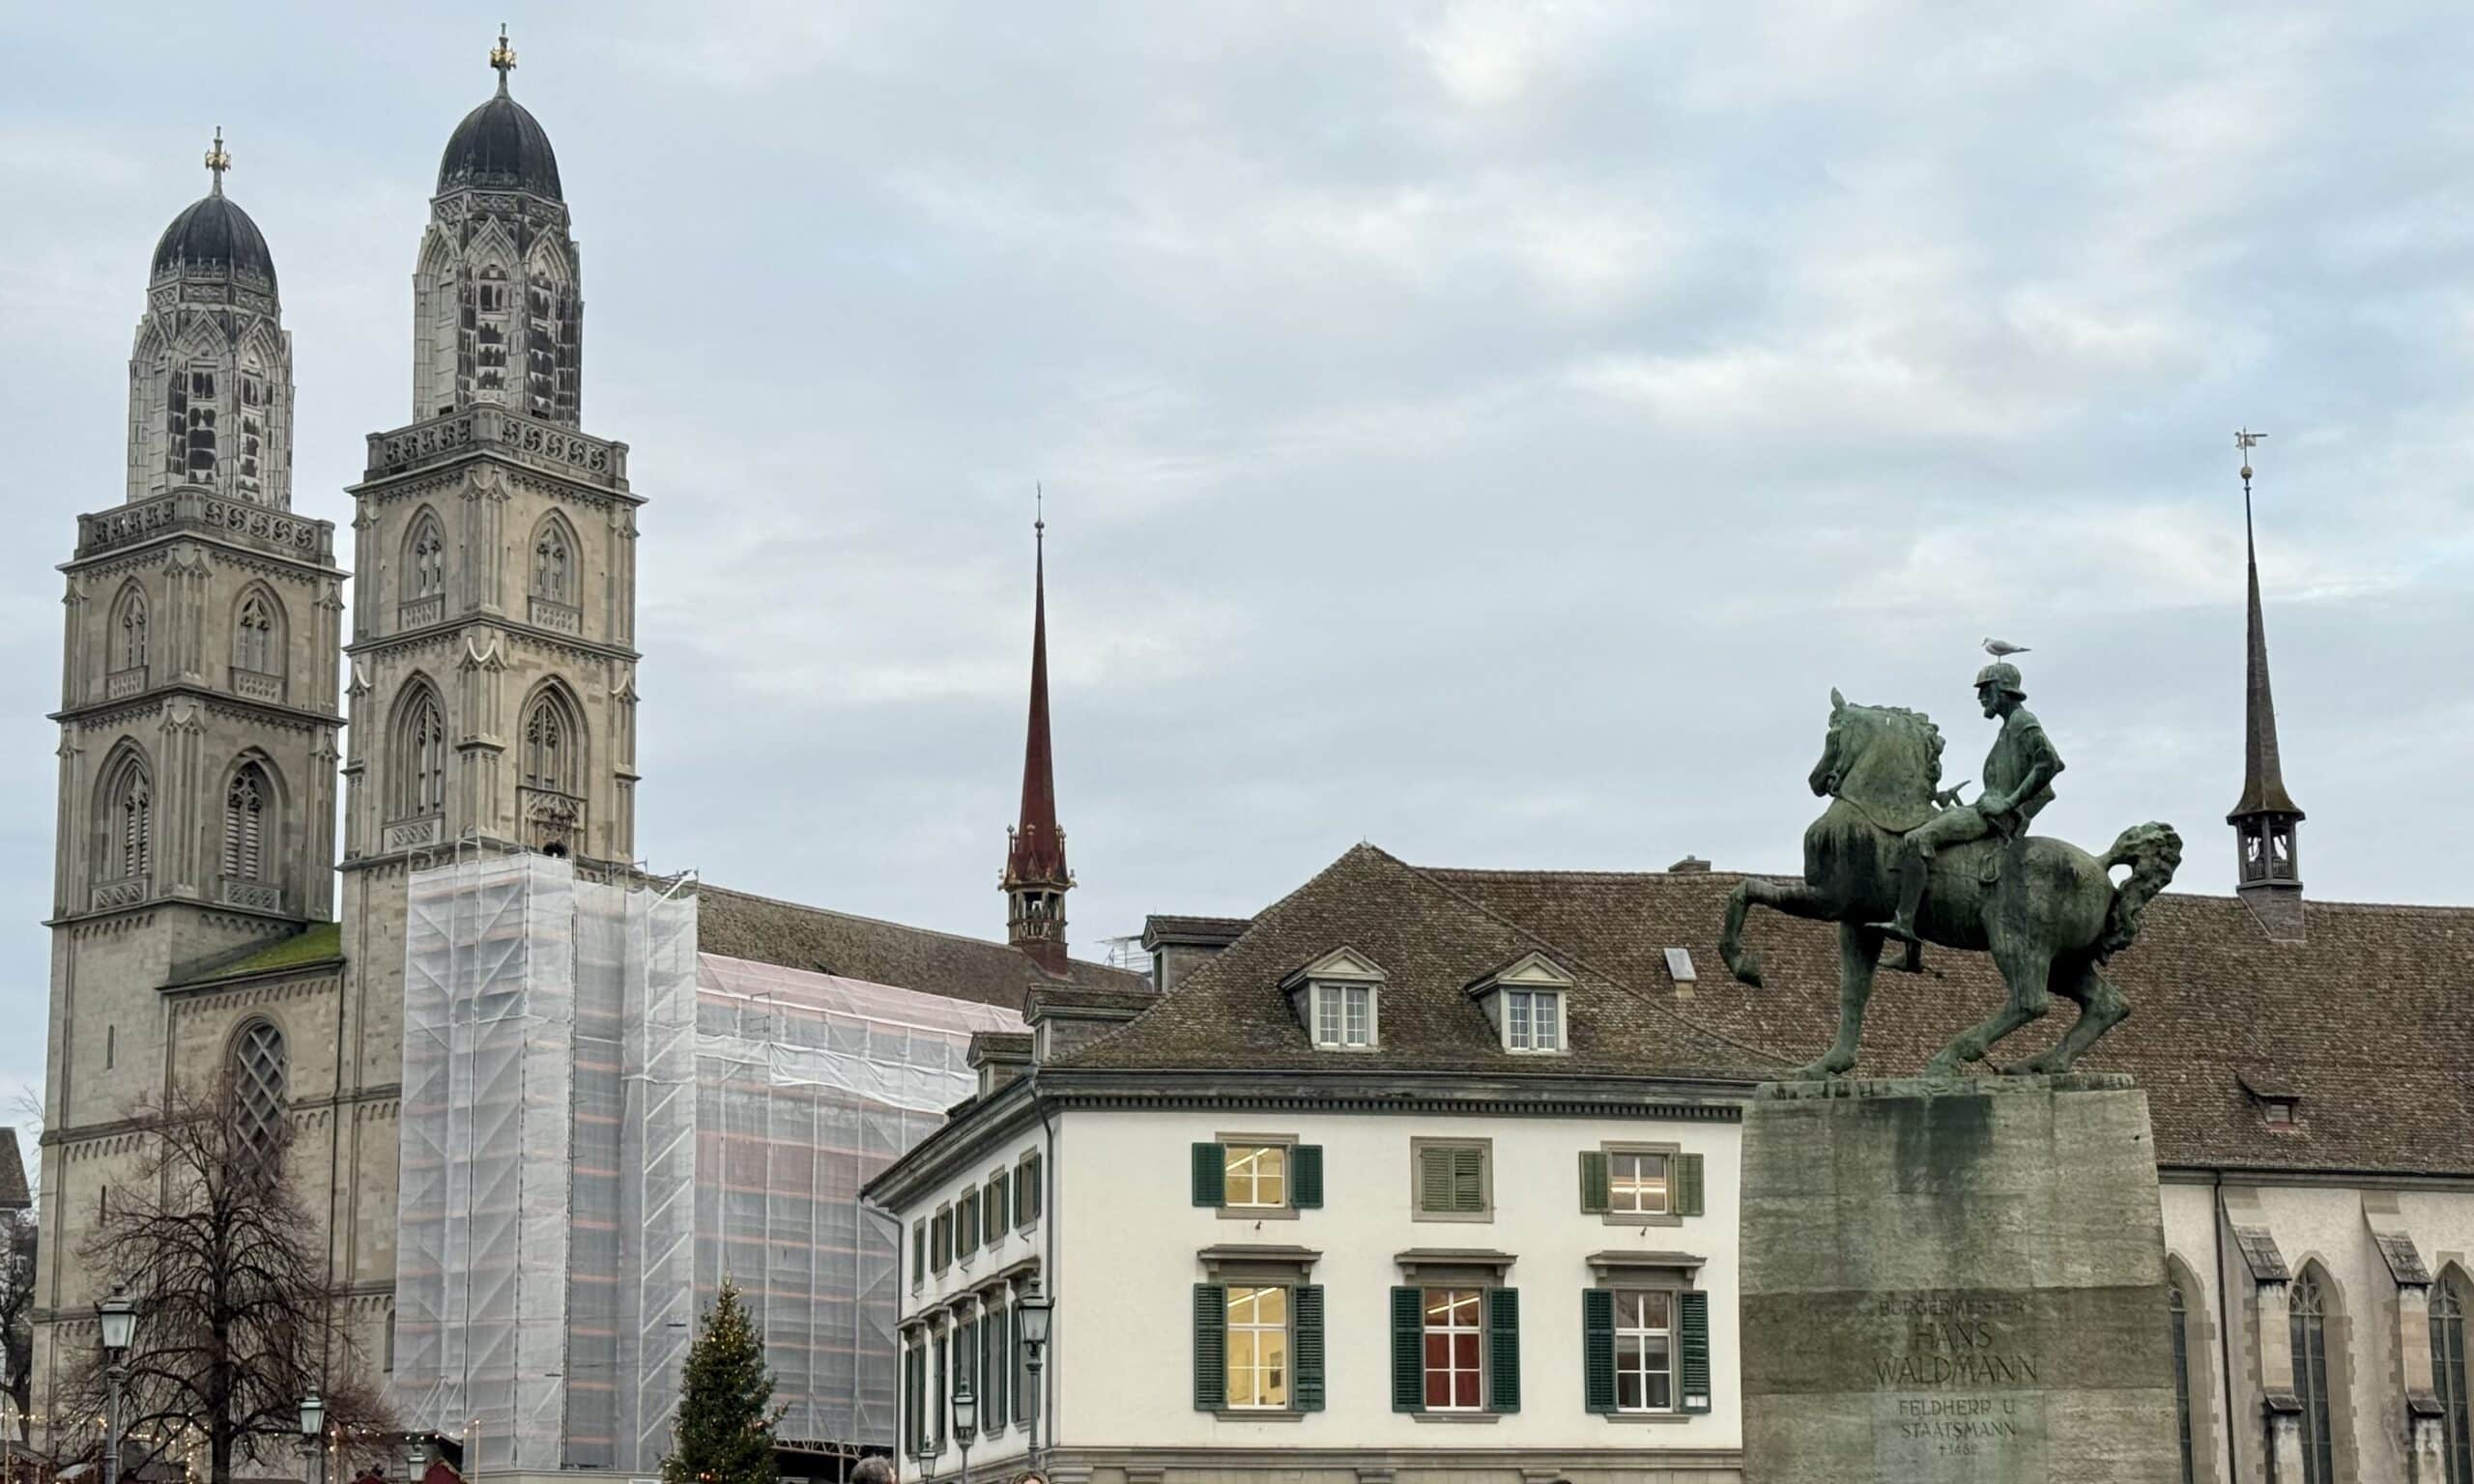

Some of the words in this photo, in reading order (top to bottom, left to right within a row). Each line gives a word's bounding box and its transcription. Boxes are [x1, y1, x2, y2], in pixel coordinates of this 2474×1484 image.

[1914, 1322, 1993, 1353] HANS
[1873, 1355, 2038, 1384] WALDMANN
[1899, 1399, 1991, 1415] FELDHERR
[1901, 1421, 2016, 1439] STAATSMANN
